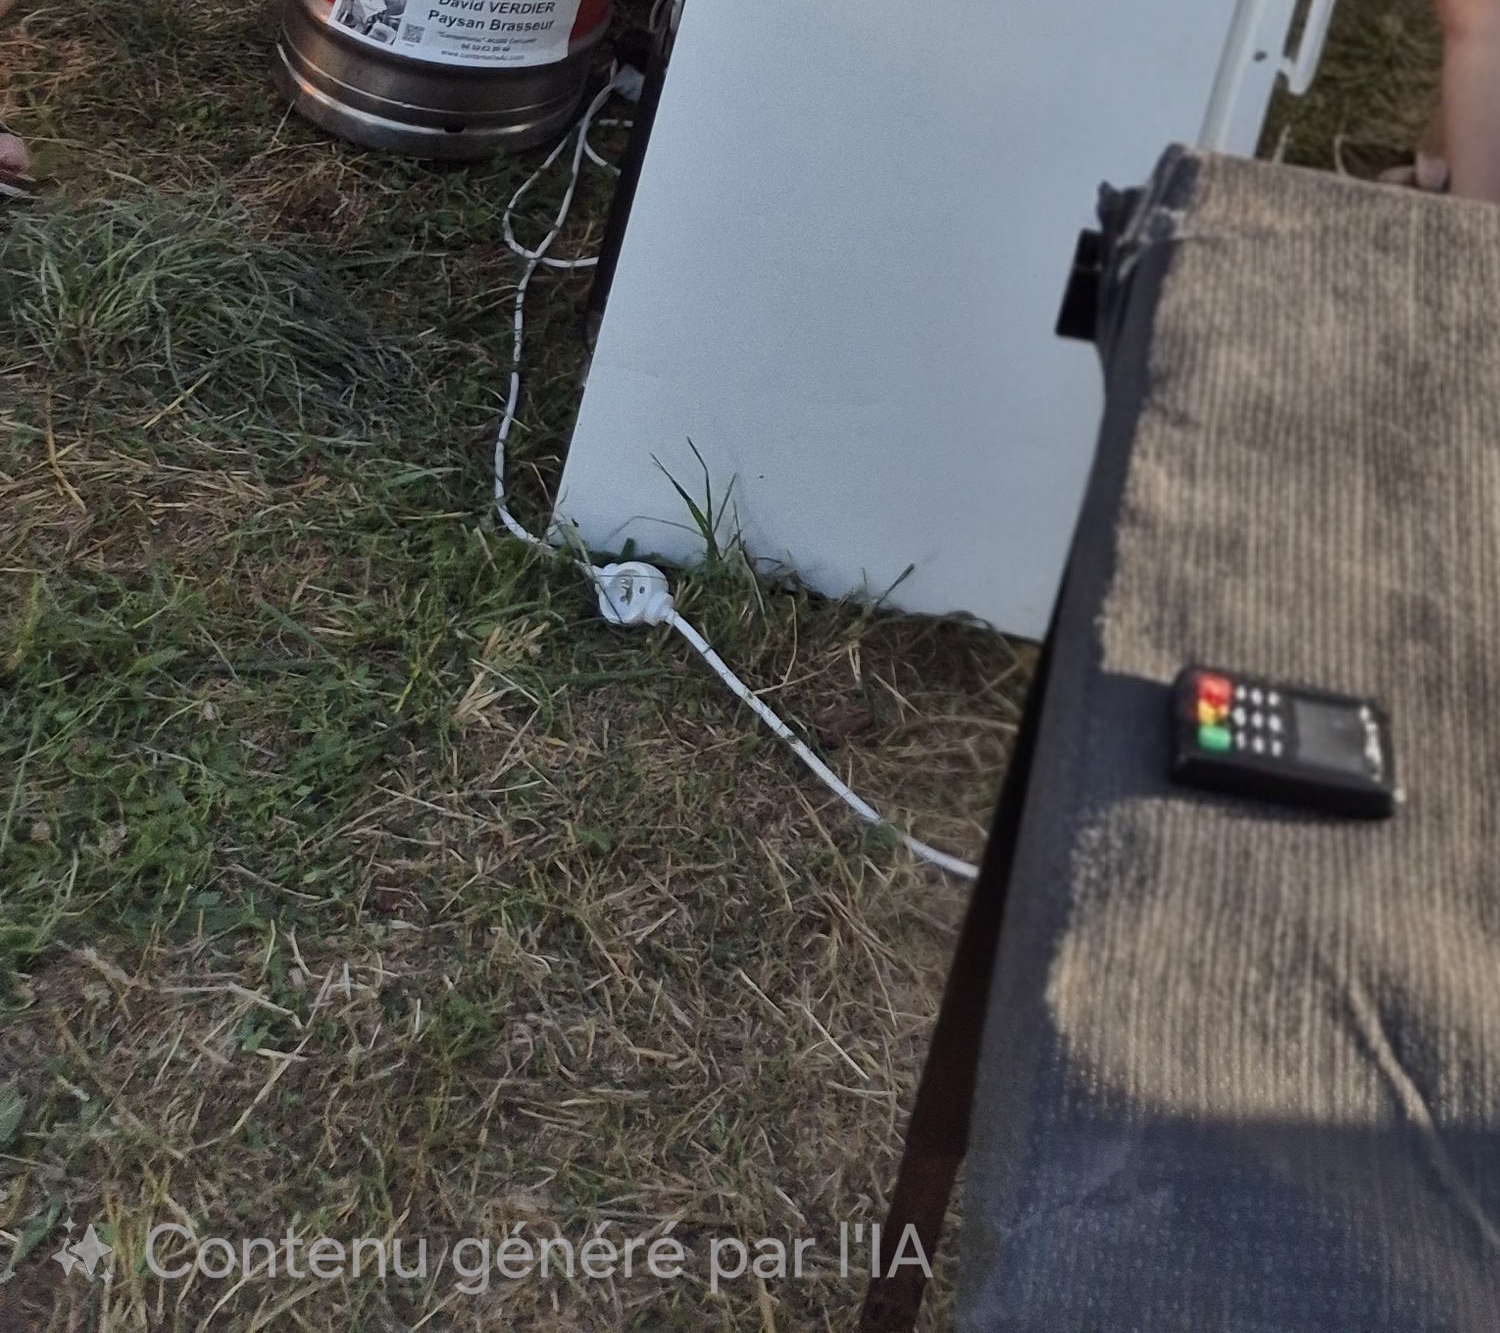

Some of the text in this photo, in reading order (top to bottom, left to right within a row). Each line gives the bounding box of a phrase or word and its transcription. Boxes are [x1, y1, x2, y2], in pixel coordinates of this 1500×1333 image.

[489, 1, 556, 15] VERDIER
[427, 9, 555, 32] Paysan Brasseur
